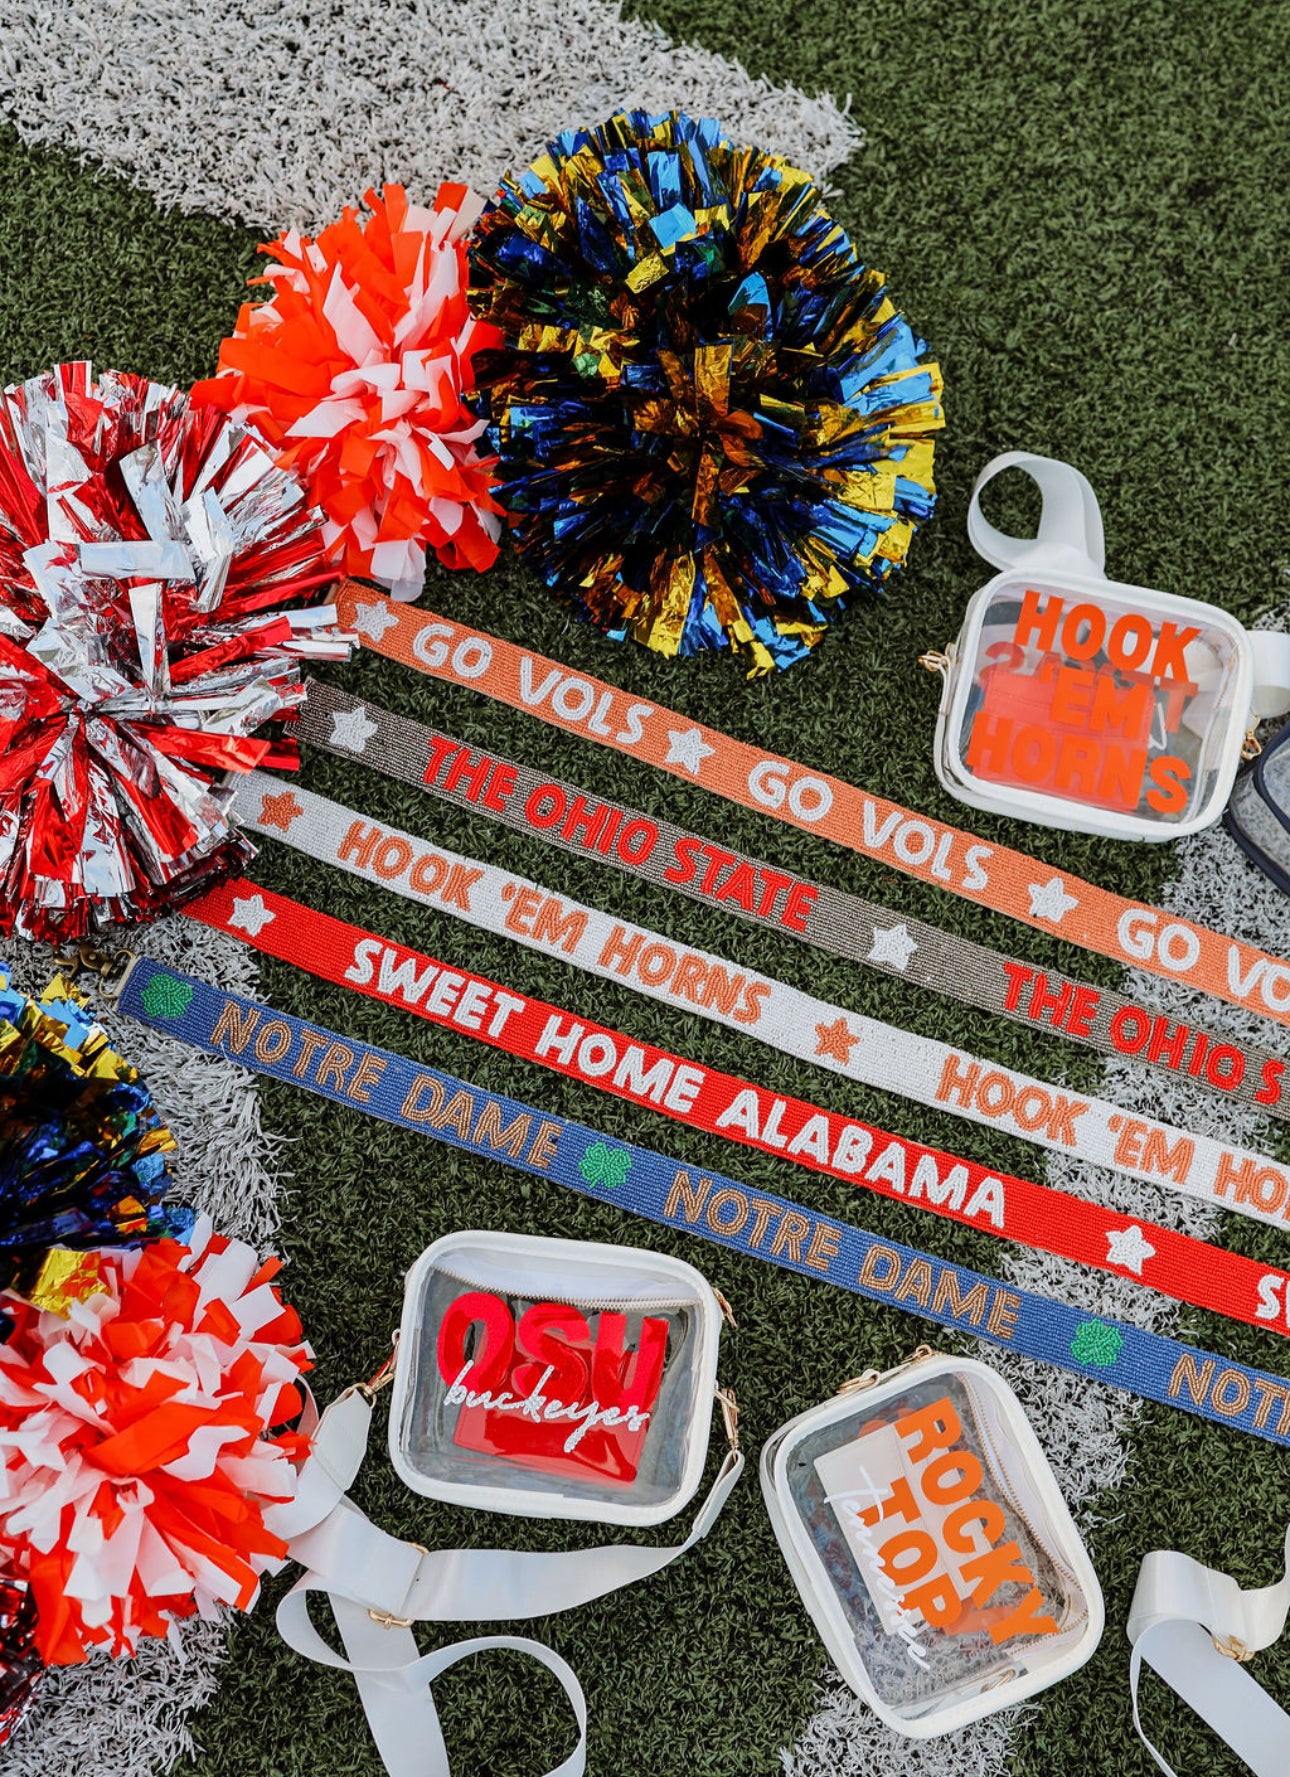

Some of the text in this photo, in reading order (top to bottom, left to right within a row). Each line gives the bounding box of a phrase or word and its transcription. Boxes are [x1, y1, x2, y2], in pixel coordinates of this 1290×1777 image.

[1013, 589, 1203, 684] HOOK
[412, 623, 493, 679] GO
[520, 656, 655, 744] VOLS
[747, 760, 834, 823] GO
[863, 801, 995, 891] VOLS
[1117, 908, 1200, 972] GO
[965, 710, 1191, 814] HORNS
[337, 820, 1290, 1221] HOOK 'EM HORNS HOOK 'EM HO
[423, 736, 520, 812] THE
[524, 784, 659, 866] OHIO
[664, 837, 819, 933] STATE
[1002, 962, 1100, 1037] THE
[1110, 1005, 1245, 1091] OHIO
[209, 1001, 388, 1102] NOTRE
[400, 1073, 563, 1170] DAME
[663, 1170, 843, 1272] NOTRE
[858, 1243, 1022, 1340] DAME
[344, 938, 1290, 1329] SWEET HOME ALABAMA S
[437, 1291, 669, 1411] OSU
[444, 1360, 650, 1453] buckeyes
[855, 1476, 963, 1628] TOP
[893, 1396, 1060, 1645] ROCKY
